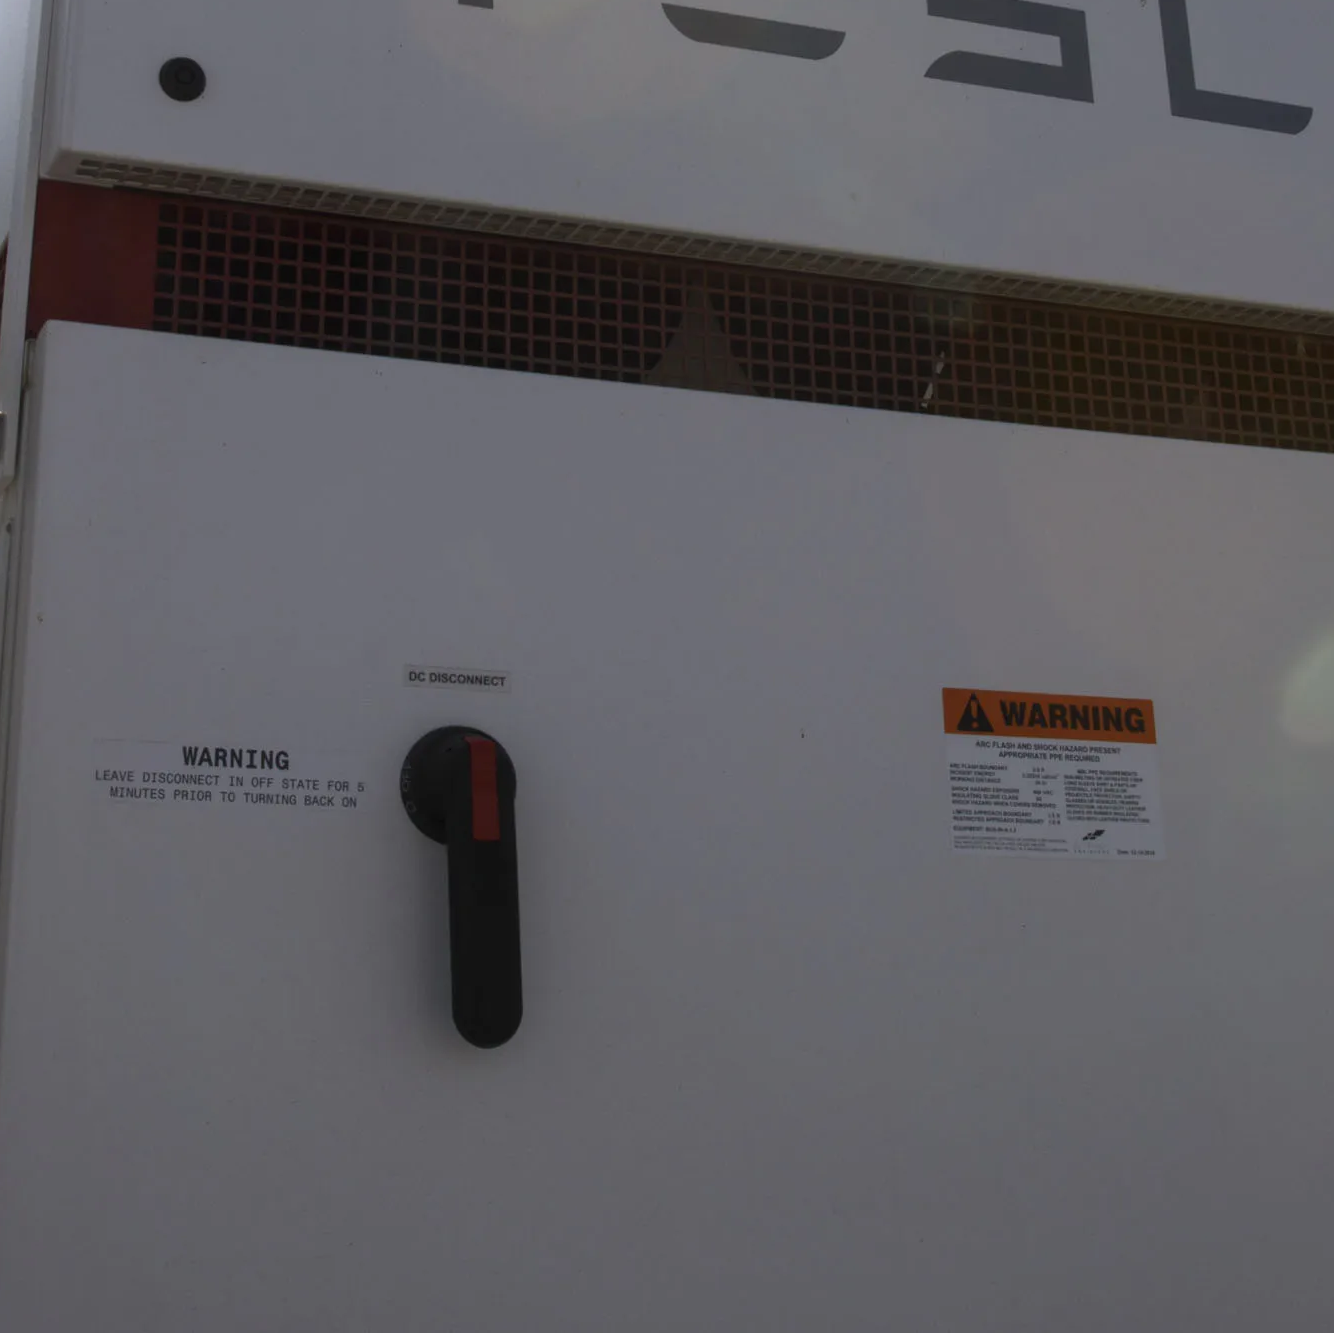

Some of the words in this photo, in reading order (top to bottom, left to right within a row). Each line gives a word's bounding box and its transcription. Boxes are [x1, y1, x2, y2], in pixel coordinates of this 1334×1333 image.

[409, 670, 426, 682] DC
[429, 672, 507, 686] DISCONNECT
[999, 700, 1146, 733] WARNING
[181, 745, 290, 771] WARNING
[975, 740, 992, 748] ARC
[992, 741, 1016, 749] FLASH
[1017, 742, 1032, 750] AND
[1034, 743, 1058, 751] SHOCK
[1059, 744, 1088, 753] HAZARD
[1089, 745, 1121, 755] PRESENT
[998, 751, 1047, 761] APPROPRIATE
[1049, 753, 1063, 762] PPE
[1065, 754, 1101, 763] REQUIRED
[95, 769, 135, 782] LEAVE
[142, 772, 220, 787] DISCONNECT
[229, 775, 244, 788] IN
[251, 776, 273, 788] OFF
[282, 778, 320, 791] STATE
[327, 780, 350, 792] FOR
[357, 782, 365, 792] 5
[109, 786, 166, 800] MINUTES
[173, 789, 212, 802] PRIOR
[220, 791, 236, 803] TO
[243, 792, 297, 806] TURNING
[304, 795, 335, 807] BACK
[342, 796, 358, 808] ON
